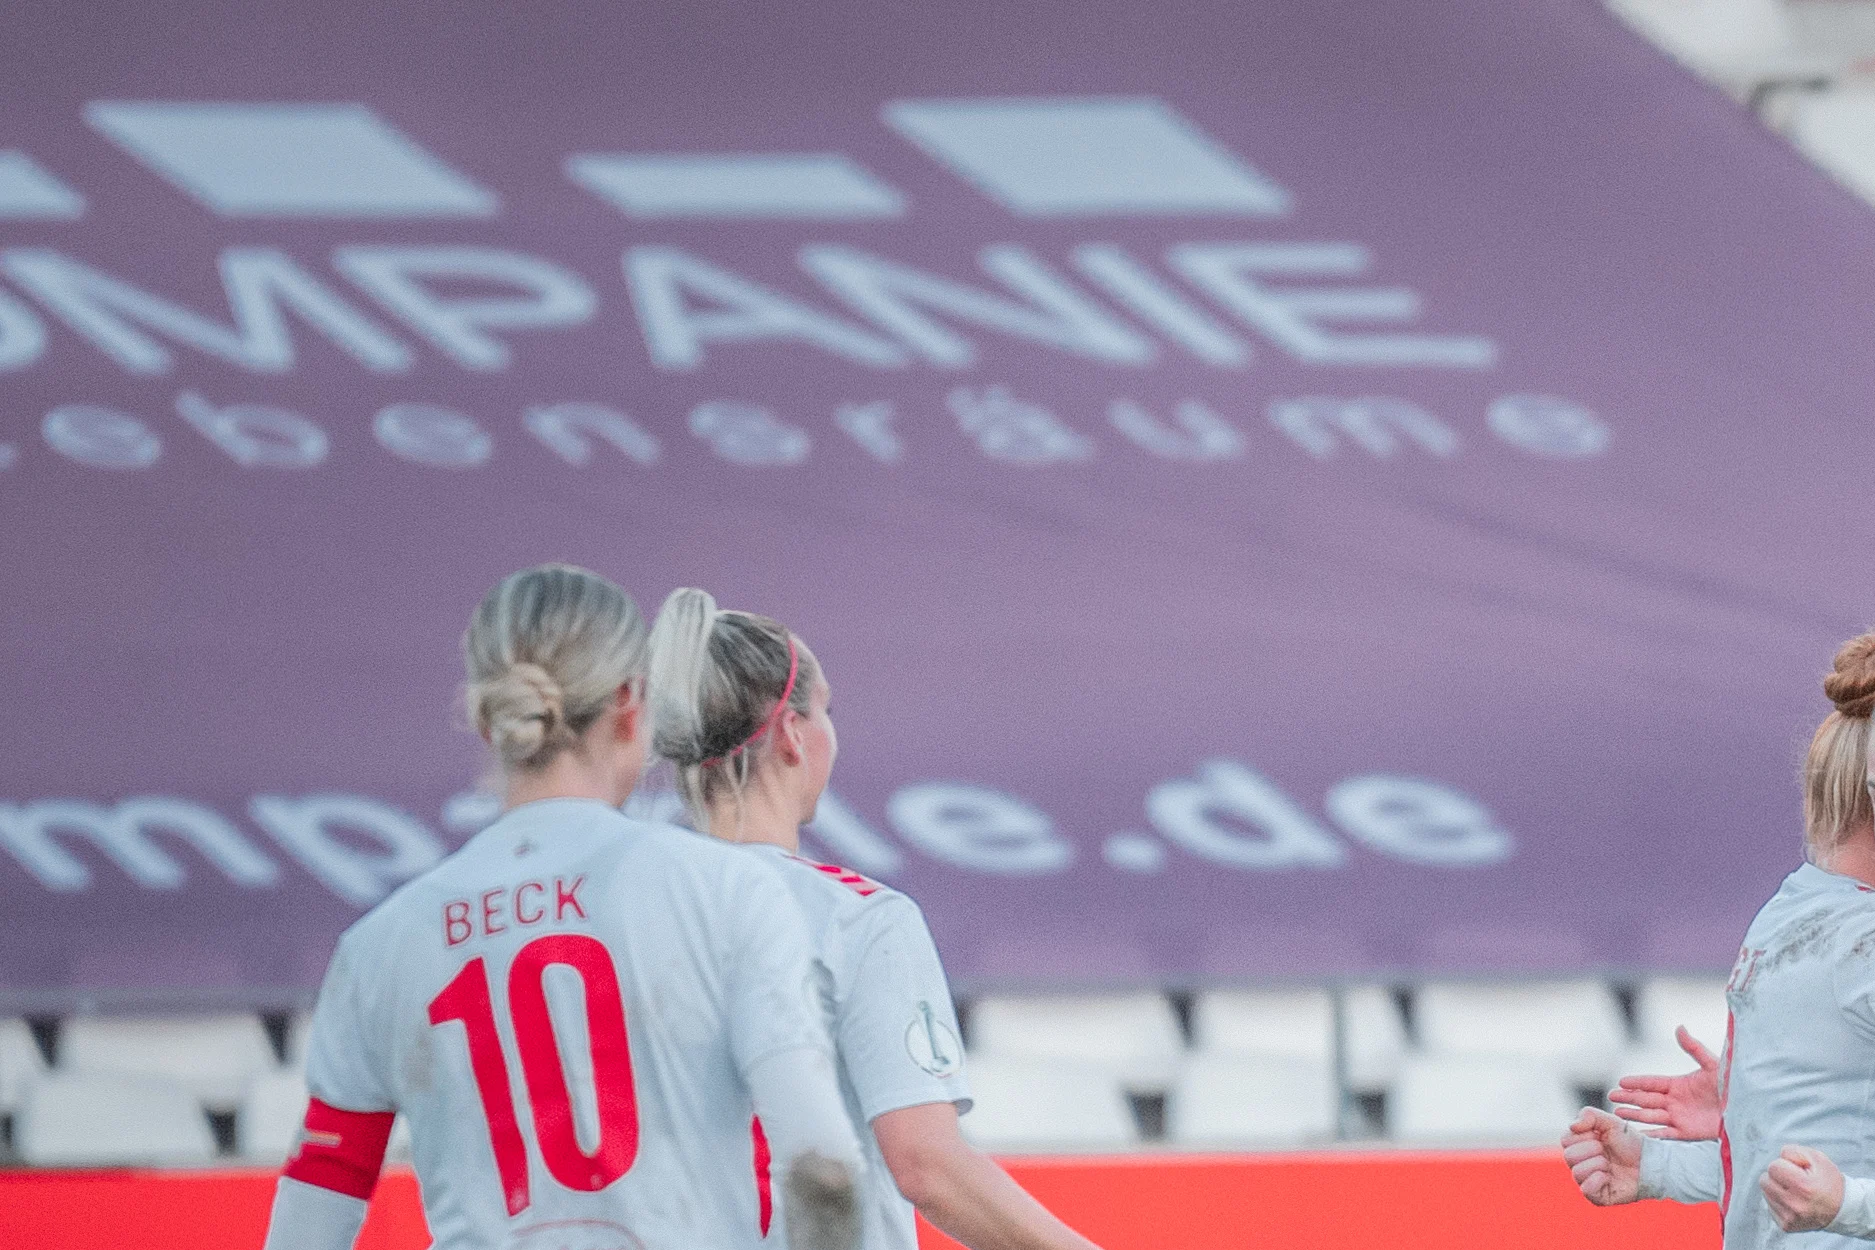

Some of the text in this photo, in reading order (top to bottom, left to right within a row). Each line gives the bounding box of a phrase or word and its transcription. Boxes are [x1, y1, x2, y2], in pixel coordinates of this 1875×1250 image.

[0, 244, 1498, 376] MPANIE
[0, 384, 1612, 470] ebensräume
[444, 875, 588, 947] BECK
[427, 933, 639, 1217] 10
